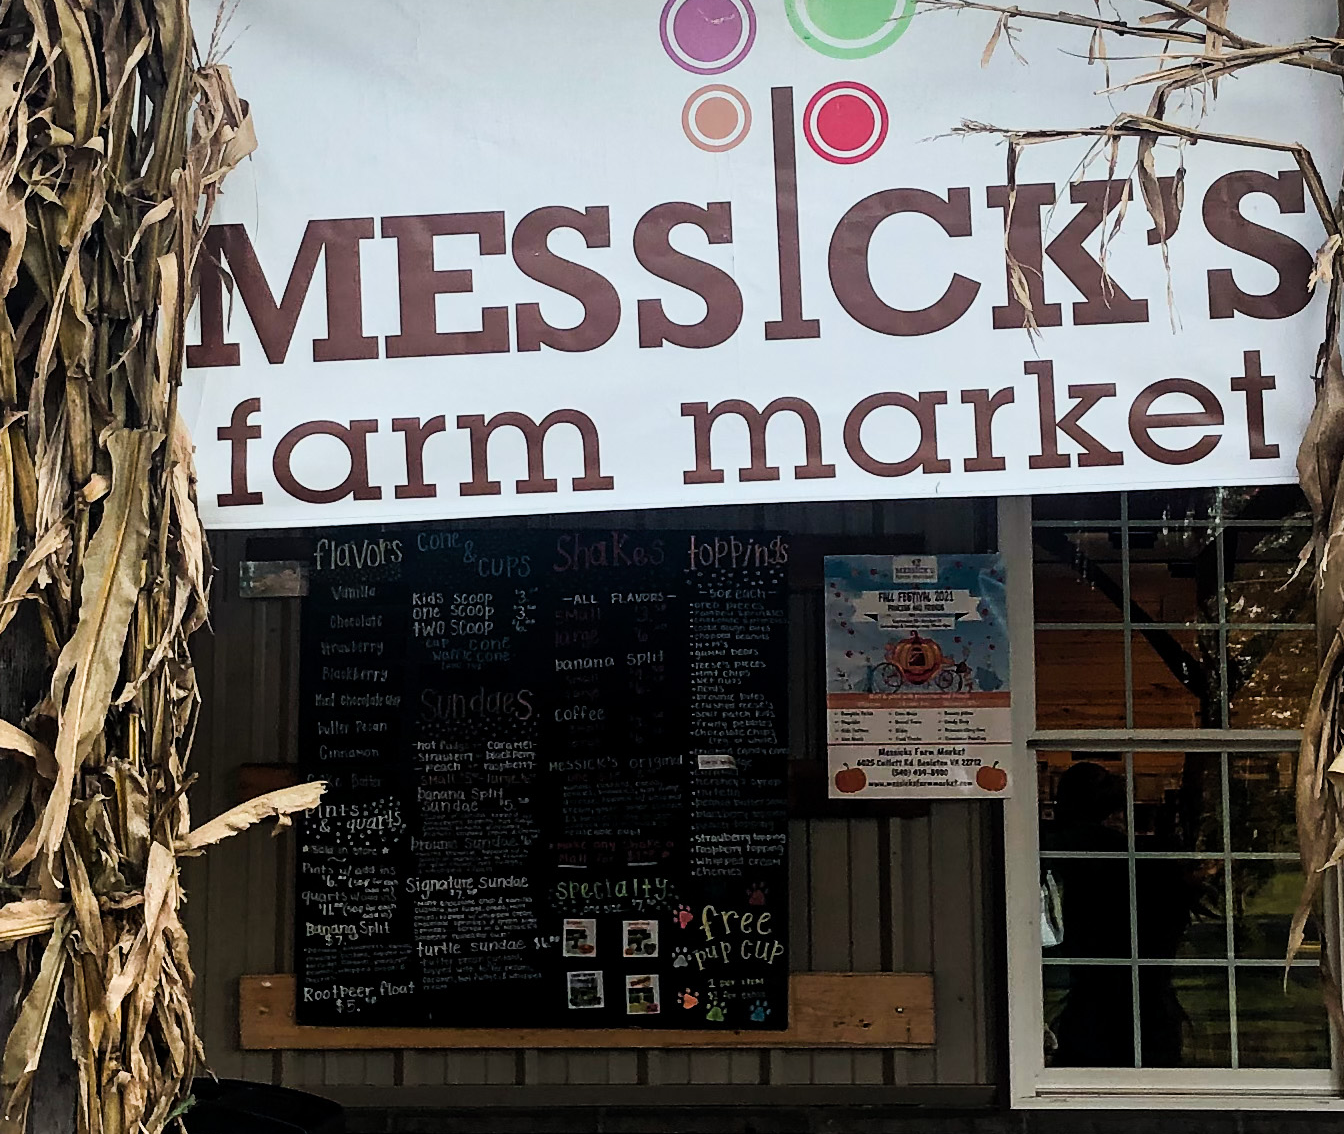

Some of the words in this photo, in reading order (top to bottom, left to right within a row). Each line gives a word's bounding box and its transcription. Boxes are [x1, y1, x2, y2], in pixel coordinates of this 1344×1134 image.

[186, 87, 1314, 368] MESSICK'S
[217, 397, 614, 507] farm
[681, 350, 1280, 485] market
[417, 531, 462, 552] Cone
[463, 539, 477, 564] &
[552, 530, 665, 572] Shakes
[687, 535, 789, 571] toppings
[314, 538, 403, 570] flavors
[478, 555, 532, 578] CUPS
[330, 586, 376, 601] Vanilla
[412, 592, 444, 606] Kids
[453, 592, 494, 606] scoop
[878, 591, 895, 603] FALL
[898, 591, 932, 604] FESTIVAL
[934, 590, 954, 602] 2021
[329, 614, 384, 629] Chocolate
[412, 606, 441, 620] one
[450, 605, 495, 620] scoop
[412, 620, 445, 637] two
[450, 619, 494, 636] scoop
[555, 656, 615, 672] banana
[626, 649, 664, 666] split
[421, 685, 534, 722] Sundaes
[554, 705, 605, 723] coffee
[914, 747, 934, 756] Farm
[937, 747, 966, 756] Market
[319, 818, 331, 833] &
[347, 809, 402, 834] quarts
[406, 875, 474, 900] Signature
[555, 877, 669, 901] specialty
[359, 921, 391, 937] Split
[698, 904, 773, 942] free
[416, 941, 462, 958] turtle
[470, 939, 527, 952] sundae
[692, 940, 732, 971] pup
[740, 939, 785, 965] cup
[379, 980, 416, 996] float
